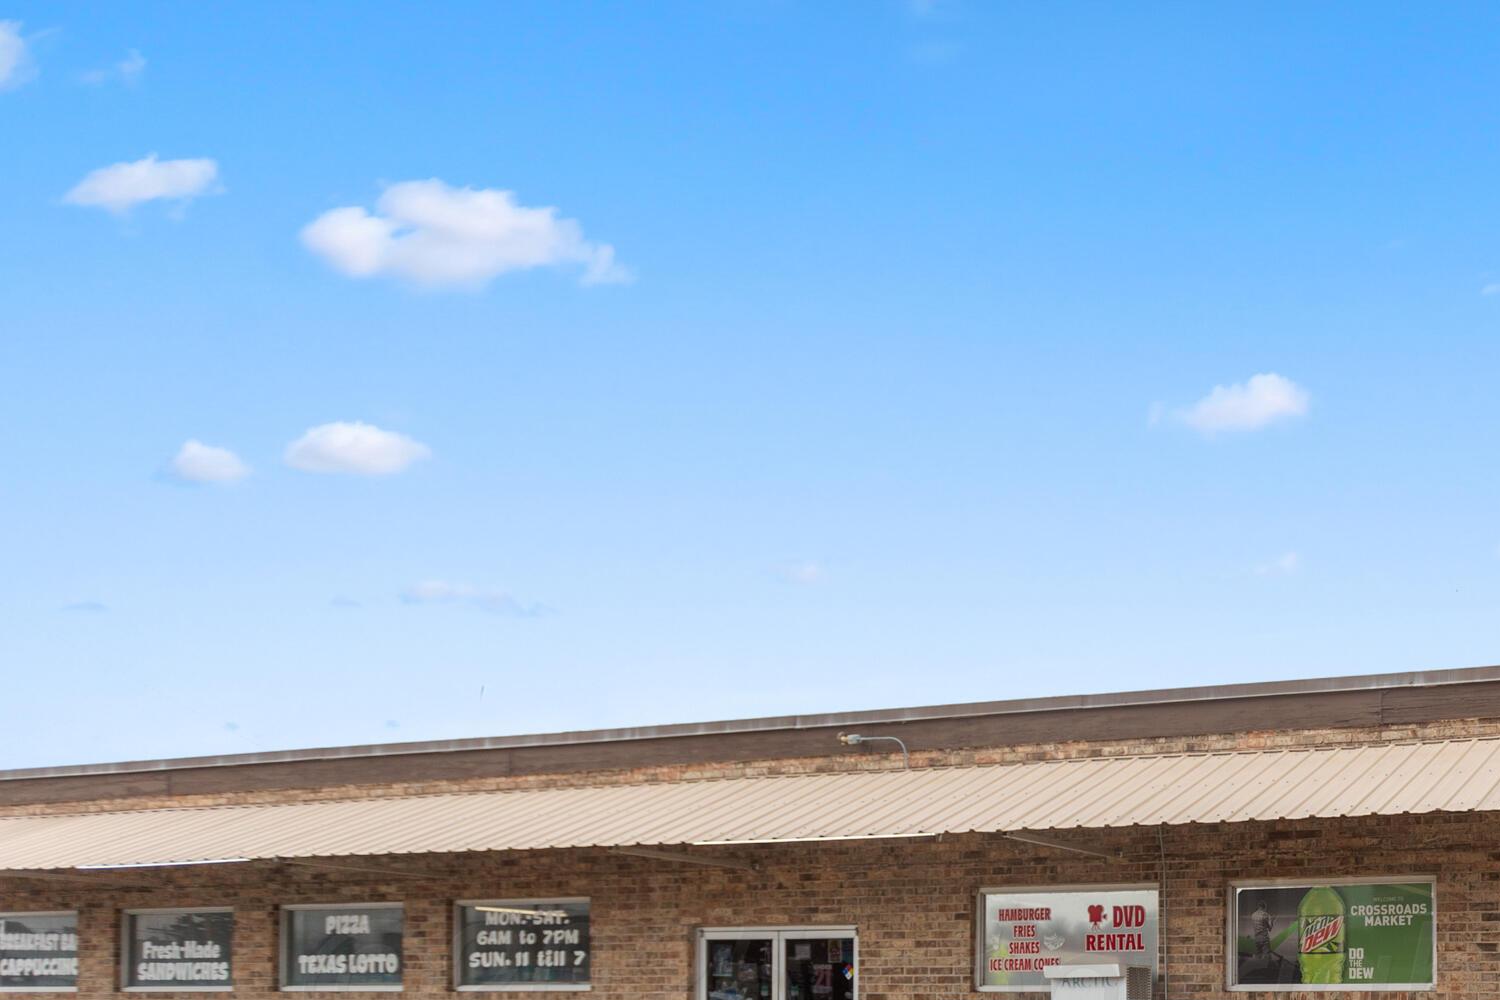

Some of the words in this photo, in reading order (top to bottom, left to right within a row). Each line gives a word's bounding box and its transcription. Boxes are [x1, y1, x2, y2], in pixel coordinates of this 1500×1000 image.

[999, 907, 1051, 921] HAMBURGER
[1113, 905, 1146, 928] DVD
[1350, 903, 1427, 916] CROSSROADS
[325, 914, 370, 935] PIZZA
[1364, 915, 1413, 927] MARKET
[476, 930, 512, 945] 6AM
[519, 930, 536, 944] to
[543, 929, 579, 944] 7PM
[1013, 925, 1035, 937] FRIES
[1009, 941, 1040, 954] SHAKES
[1086, 933, 1145, 951] RENTAL
[469, 951, 511, 968] SUN.
[537, 950, 566, 966] till
[573, 951, 586, 966] 7
[1348, 948, 1365, 960] DO
[137, 961, 229, 980] SANDWICHES
[298, 953, 347, 974] TEXAS
[348, 953, 398, 973] LOTTO
[990, 959, 1002, 971] ICE
[1004, 958, 1032, 971] CREAM
[1348, 967, 1374, 979] DEW
